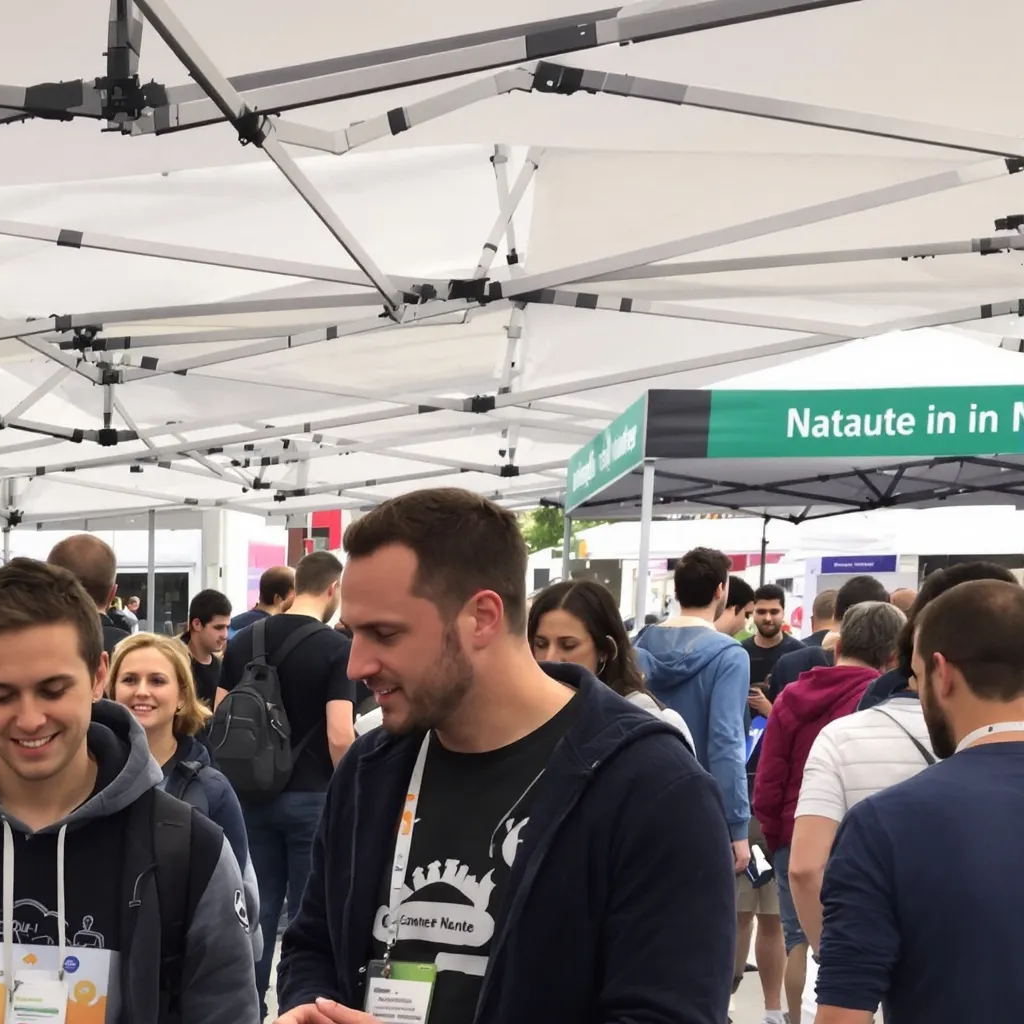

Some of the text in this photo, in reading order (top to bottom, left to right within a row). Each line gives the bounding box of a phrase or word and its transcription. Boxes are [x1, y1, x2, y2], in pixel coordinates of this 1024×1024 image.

[787, 408, 916, 438] Nataute
[927, 404, 956, 434] in
[969, 403, 998, 433] in
